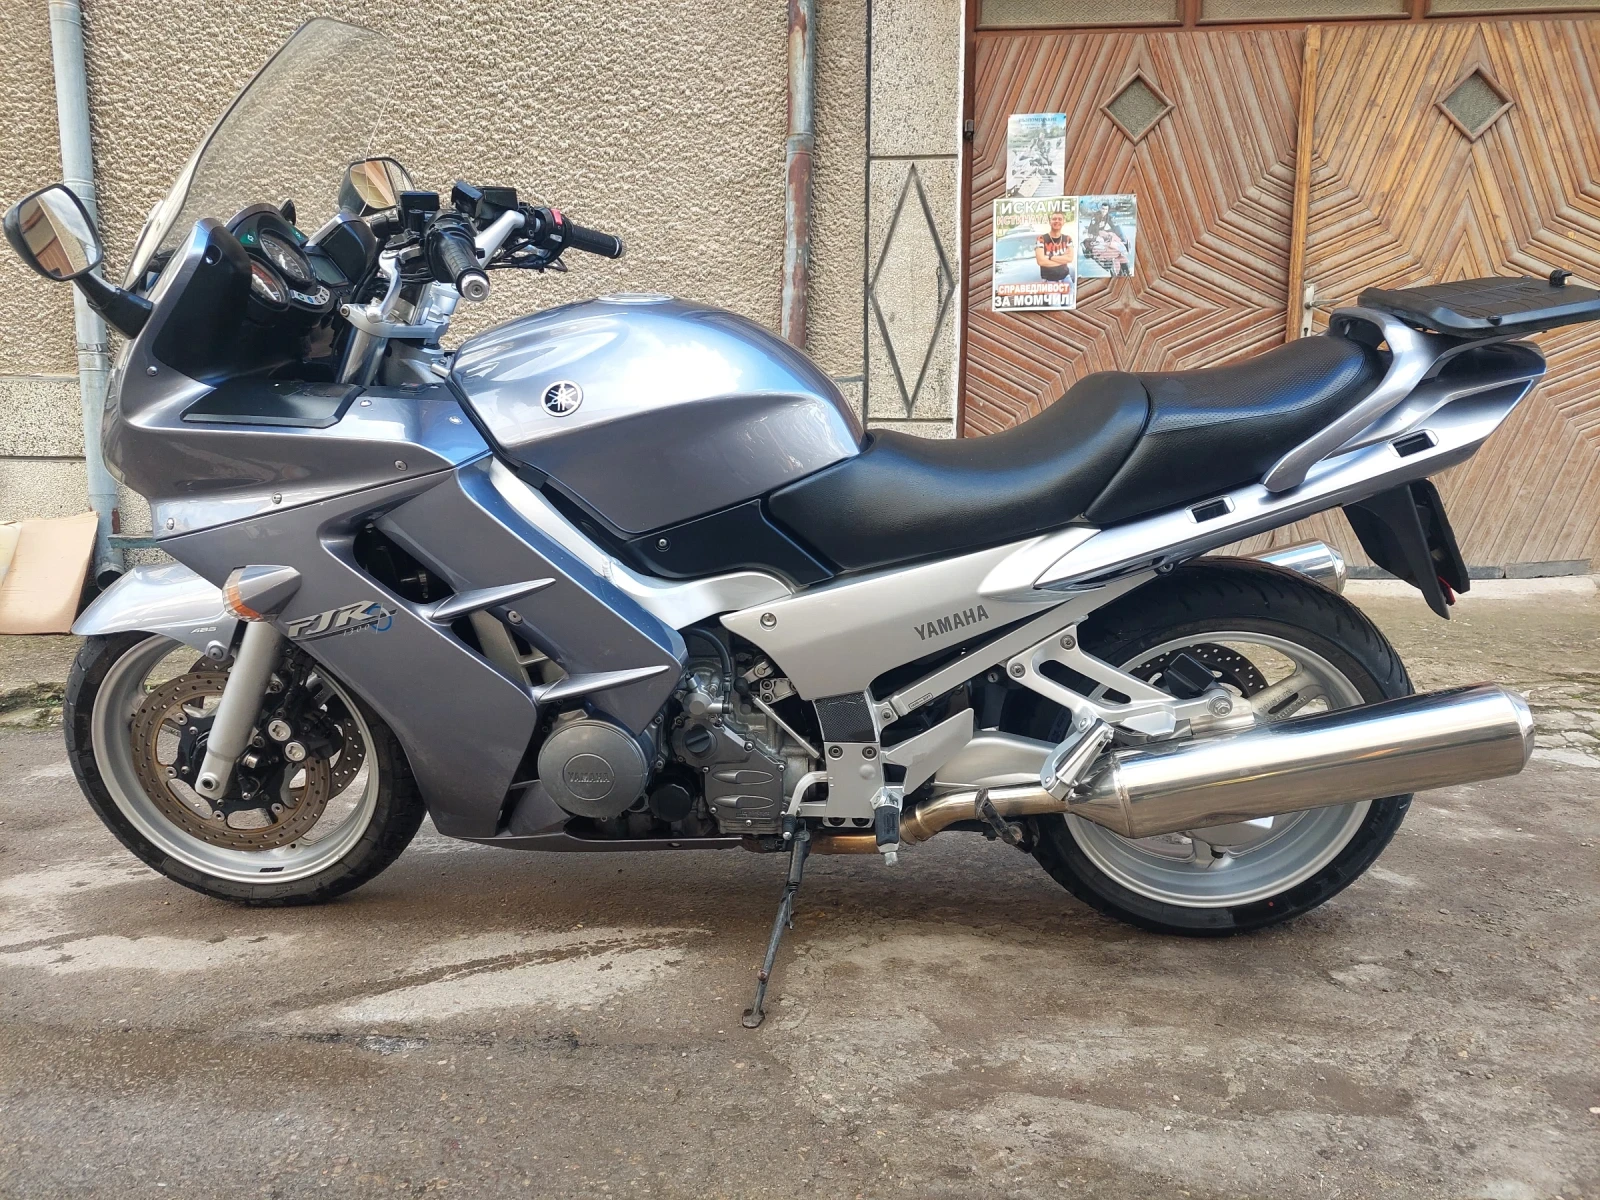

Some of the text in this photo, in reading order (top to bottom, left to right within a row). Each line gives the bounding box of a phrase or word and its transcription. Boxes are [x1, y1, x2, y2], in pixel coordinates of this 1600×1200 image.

[999, 283, 1070, 295] СПРАВЕДЛИВОСТ
[995, 294, 1074, 307] ЗА МОМЧИЛ!
[286, 600, 380, 638] FJR
[914, 604, 990, 641] YAMAHA
[190, 626, 218, 635] ABS
[342, 623, 371, 637] 1300
[567, 771, 611, 783] YAMAHA
